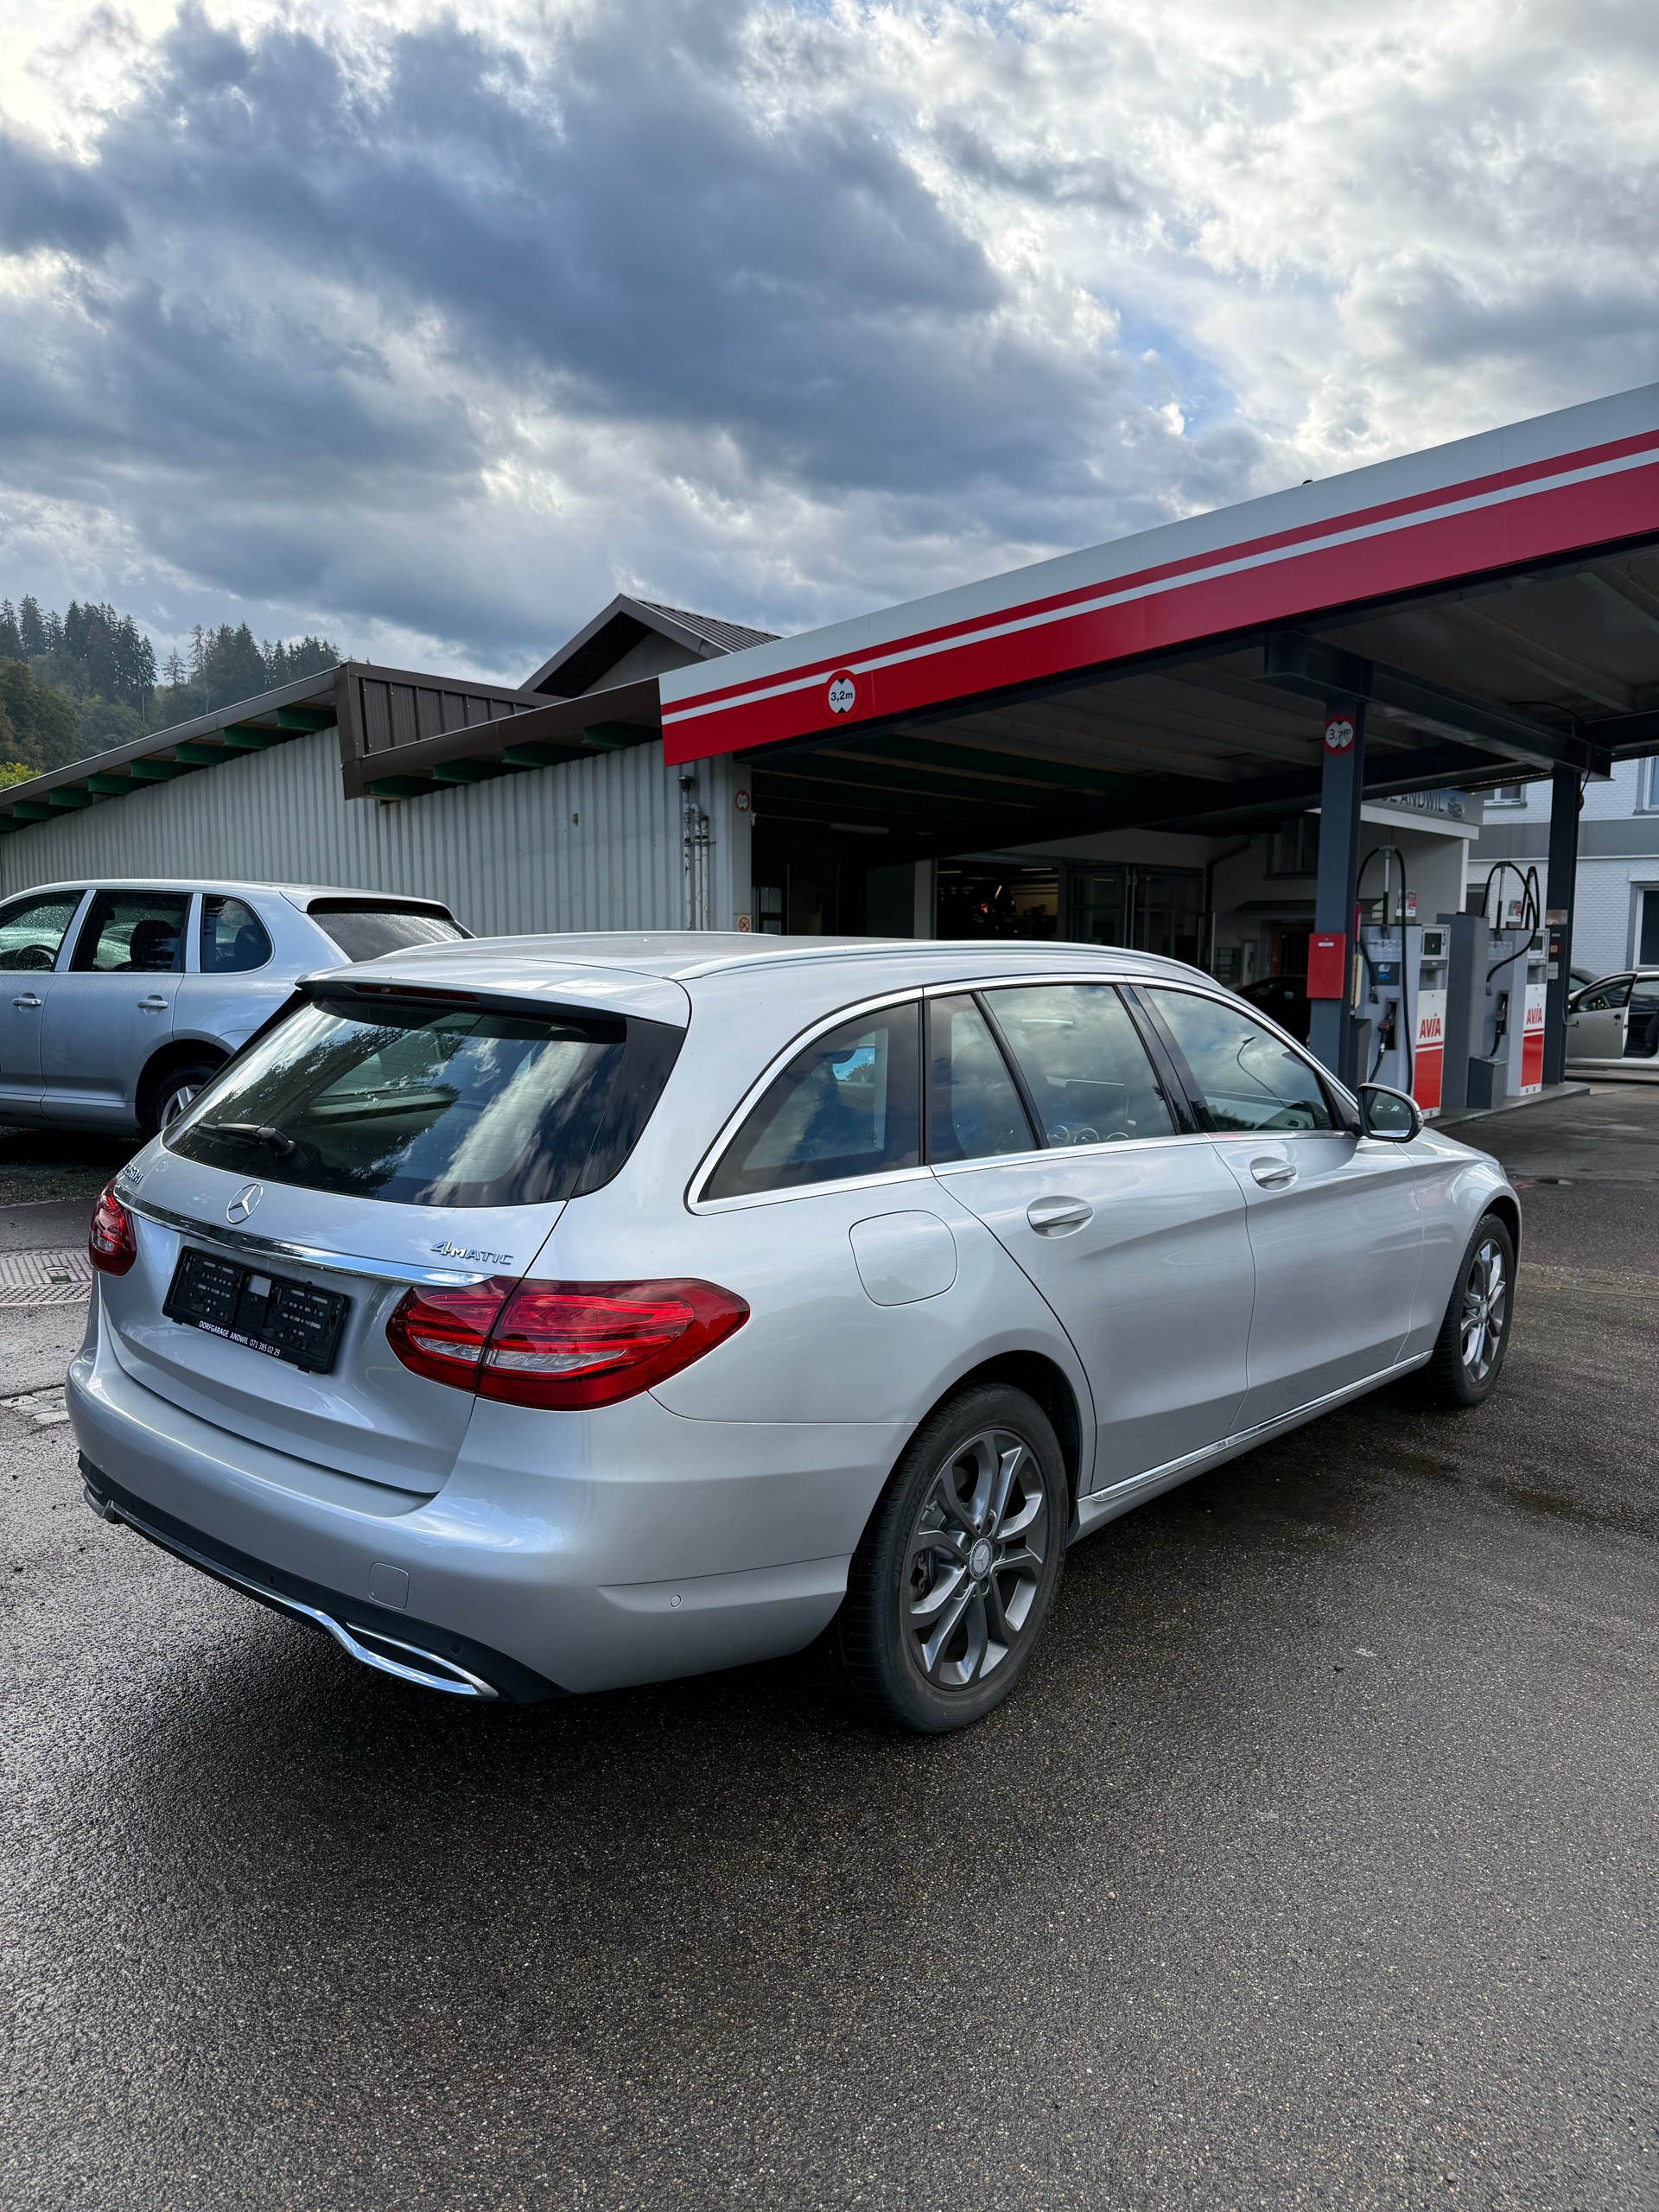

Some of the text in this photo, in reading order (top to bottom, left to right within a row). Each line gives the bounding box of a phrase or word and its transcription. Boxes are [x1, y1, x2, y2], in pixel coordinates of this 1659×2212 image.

[830, 690, 854, 702] 3,2m
[430, 1241, 514, 1265] 4MATIC
[199, 1320, 281, 1357] DORFGARAGE ANDWIL 071 385 02 29
